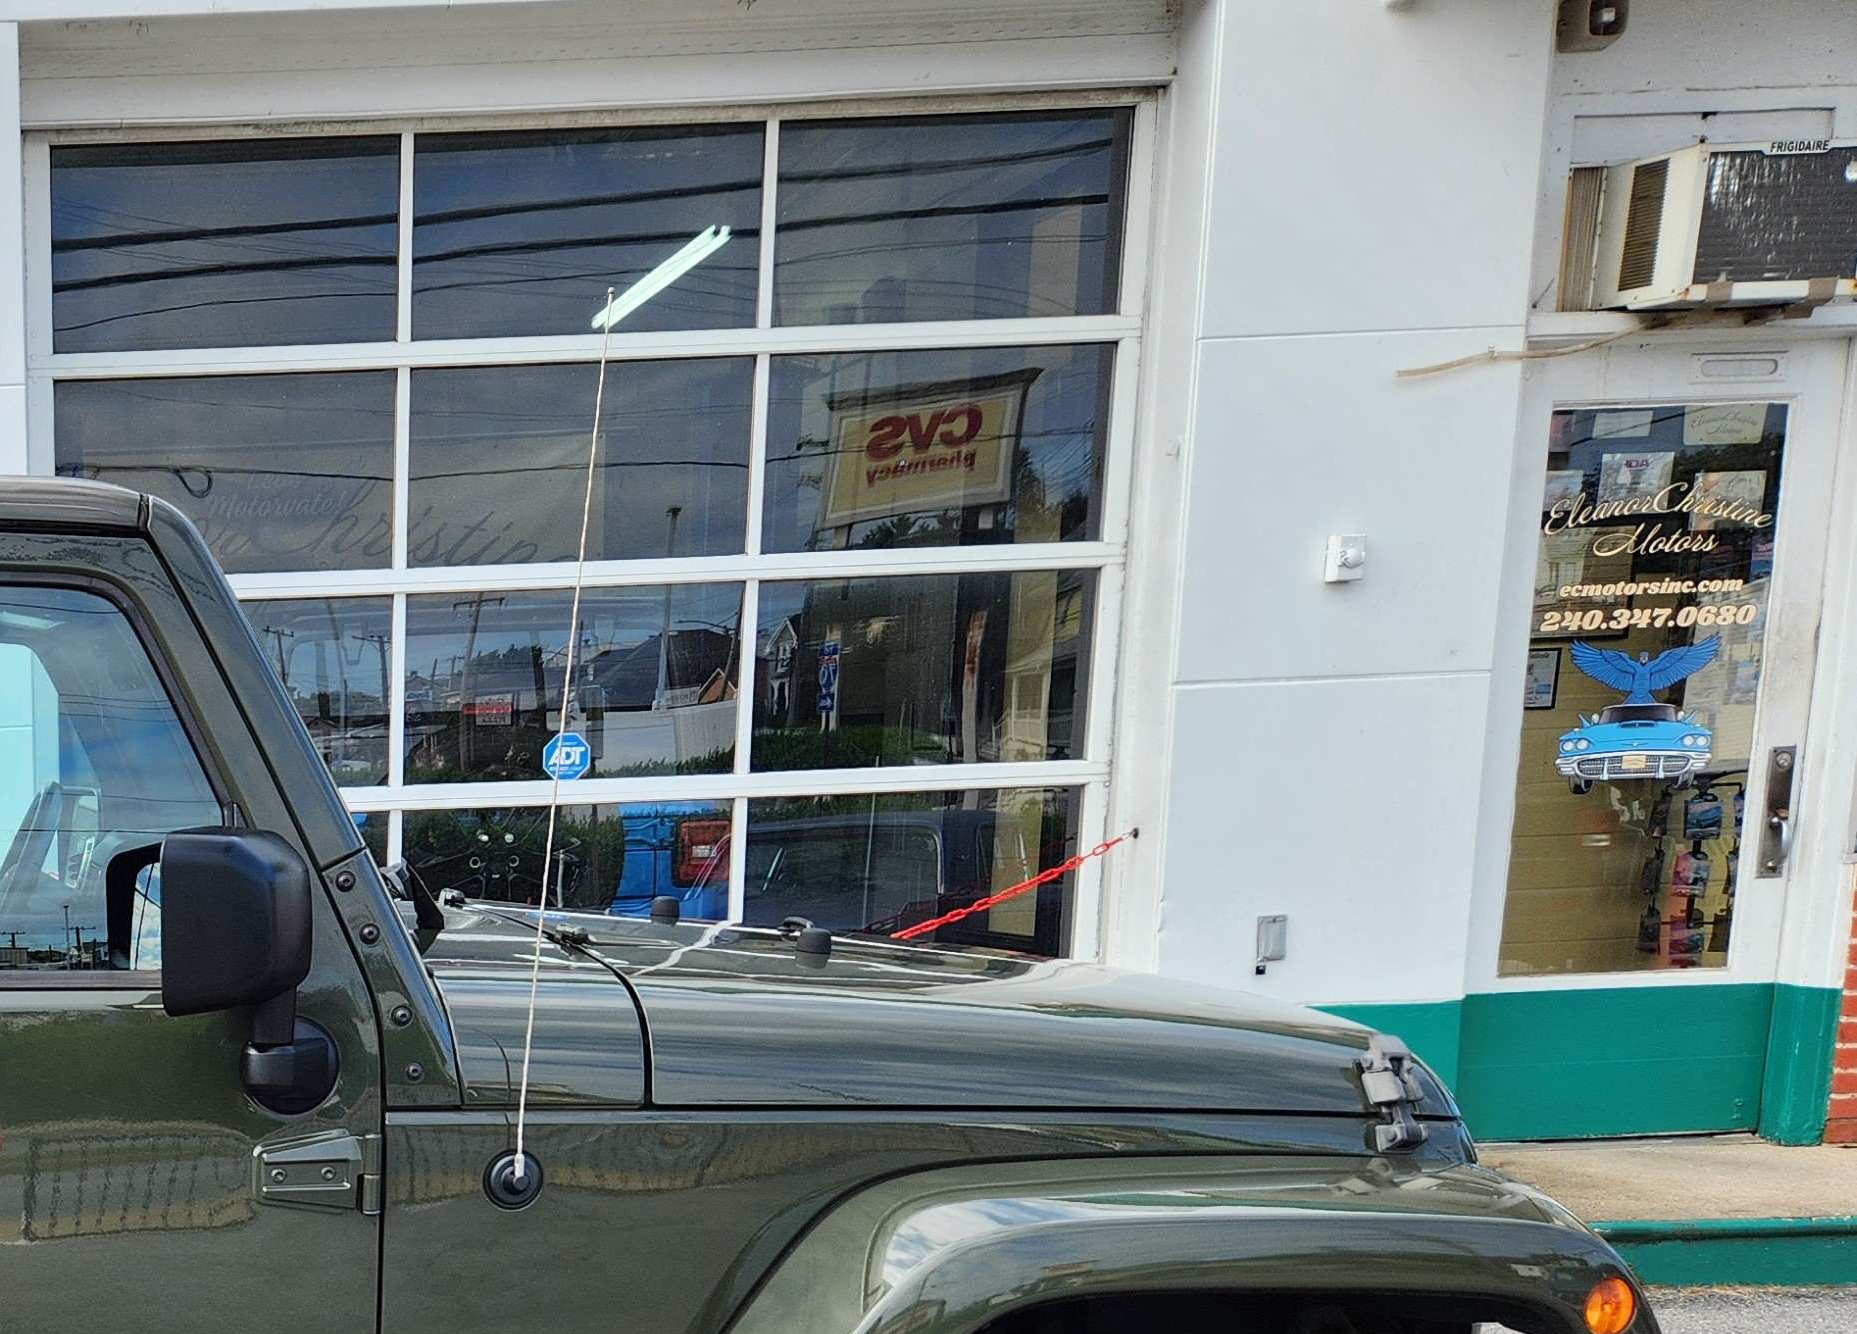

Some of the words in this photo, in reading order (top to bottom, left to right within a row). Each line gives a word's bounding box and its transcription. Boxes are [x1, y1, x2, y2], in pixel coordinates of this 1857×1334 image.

[1770, 140, 1830, 153] FRIGIDAIRE
[1593, 522, 1719, 557] Motors
[1559, 577, 1743, 598] ecmotorsinc.com
[1539, 604, 1758, 631] 240.347.0680
[548, 747, 586, 765] ADT
